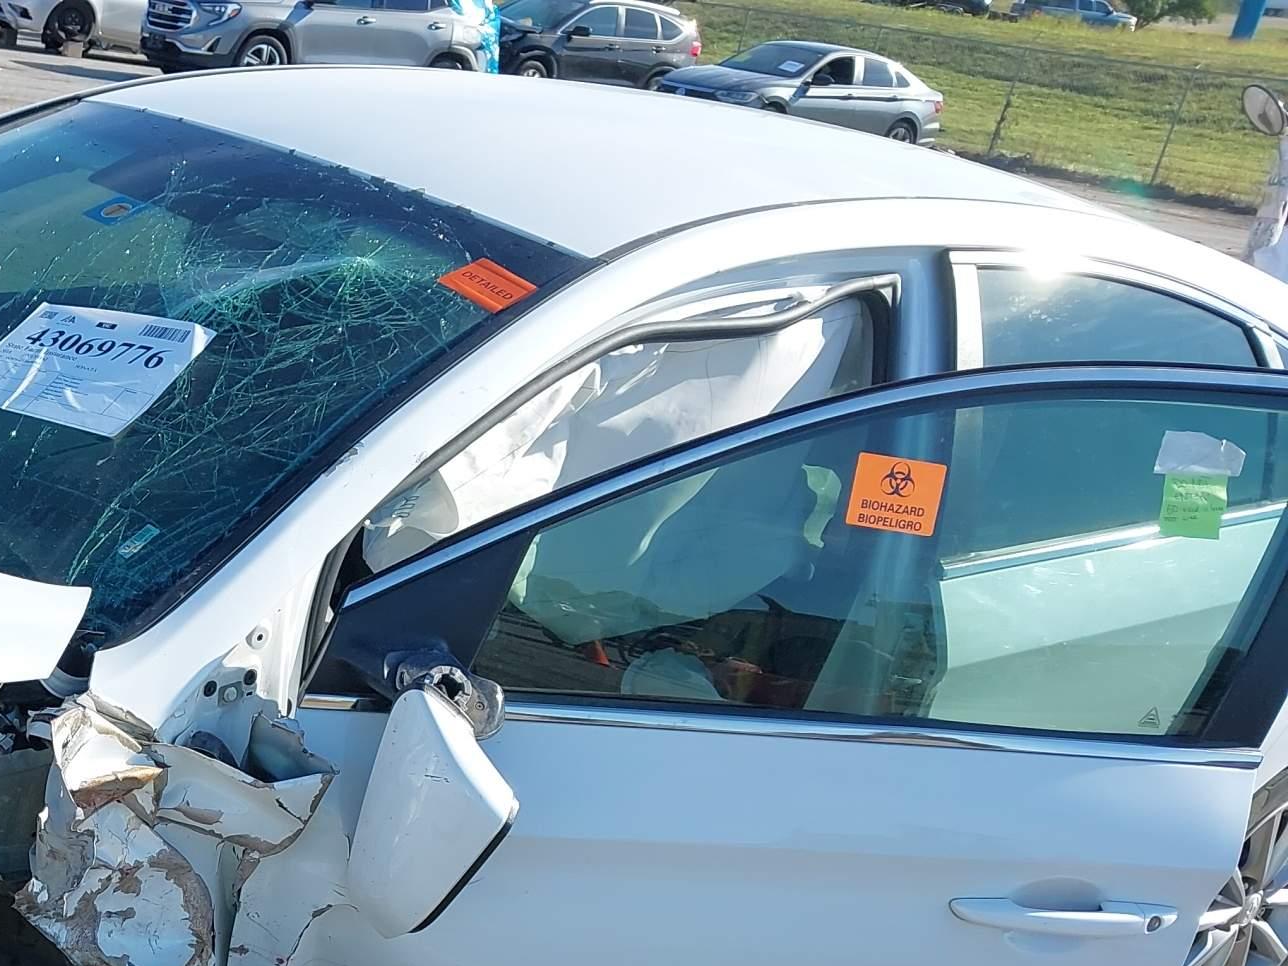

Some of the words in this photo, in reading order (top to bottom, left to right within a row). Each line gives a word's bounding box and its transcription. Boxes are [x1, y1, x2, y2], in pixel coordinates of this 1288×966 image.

[462, 271, 513, 300] DETAILED
[25, 327, 169, 369] 43069776
[860, 499, 925, 517] BIOHAZARD
[857, 513, 922, 531] BIOPELIGRO
